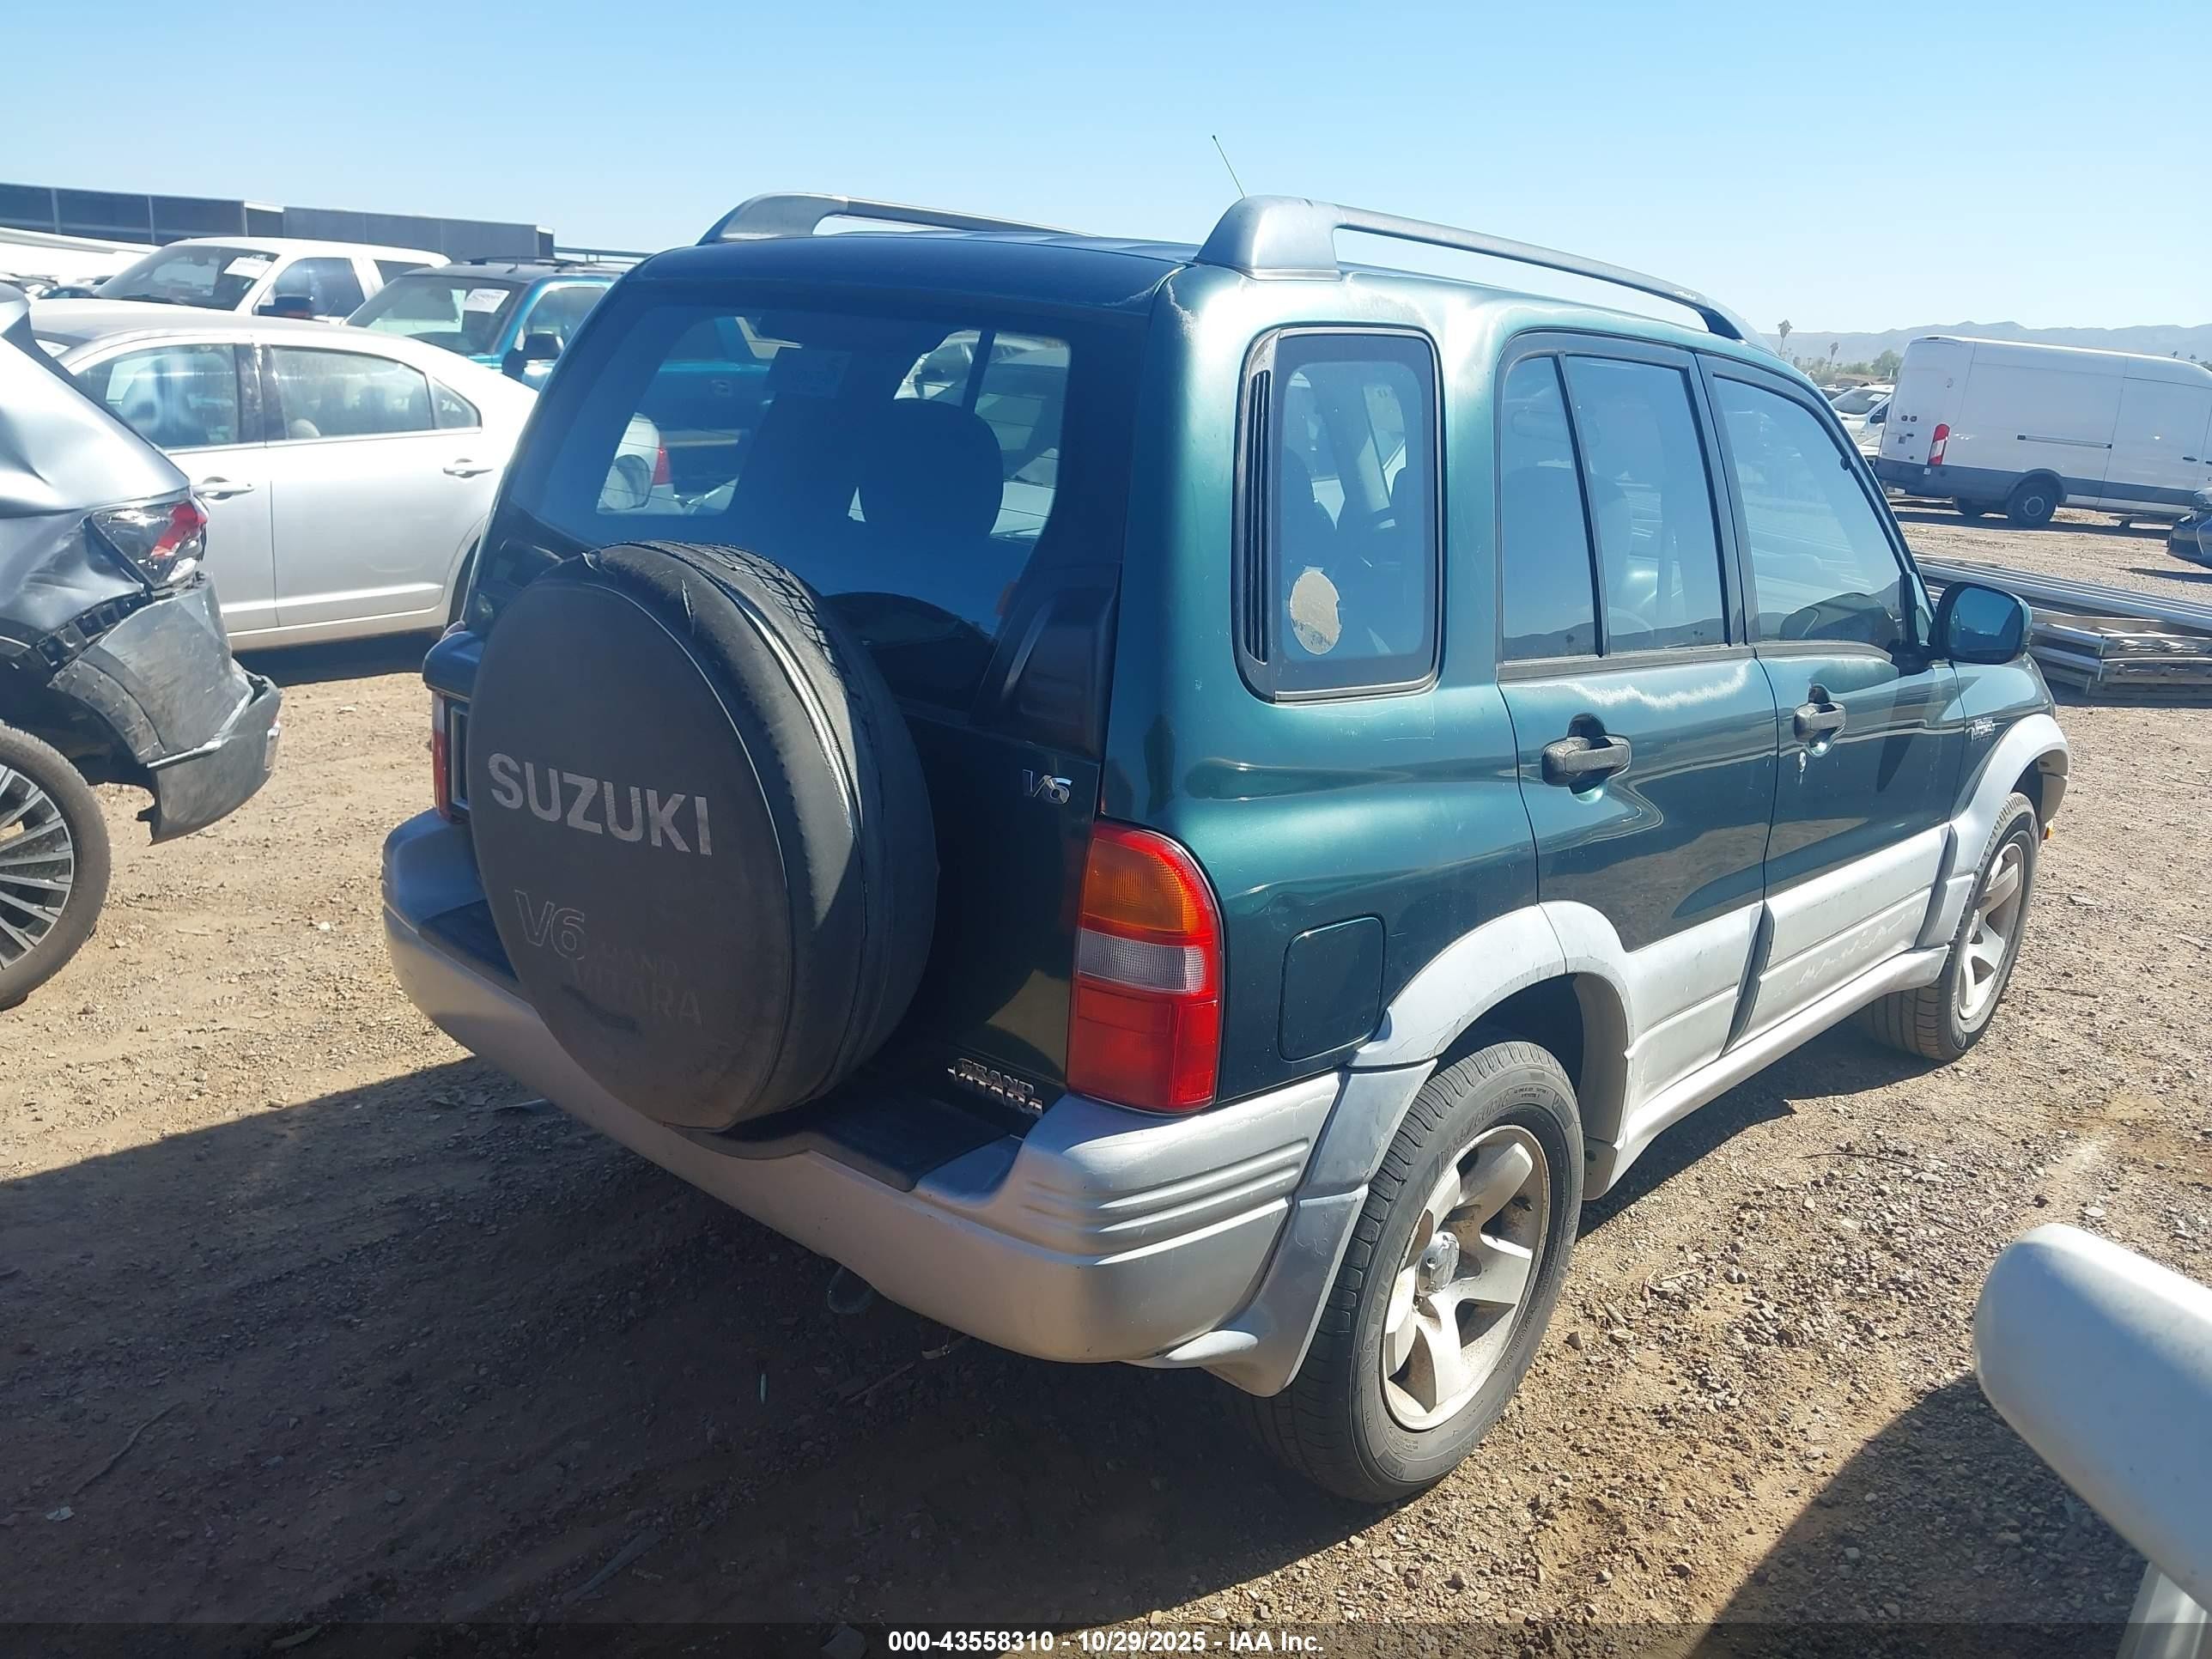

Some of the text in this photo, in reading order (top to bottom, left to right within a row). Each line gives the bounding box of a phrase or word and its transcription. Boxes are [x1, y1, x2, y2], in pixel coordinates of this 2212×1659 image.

[487, 752, 714, 856] SUZUKI
[1022, 769, 1073, 805] V6
[514, 888, 586, 961] V6
